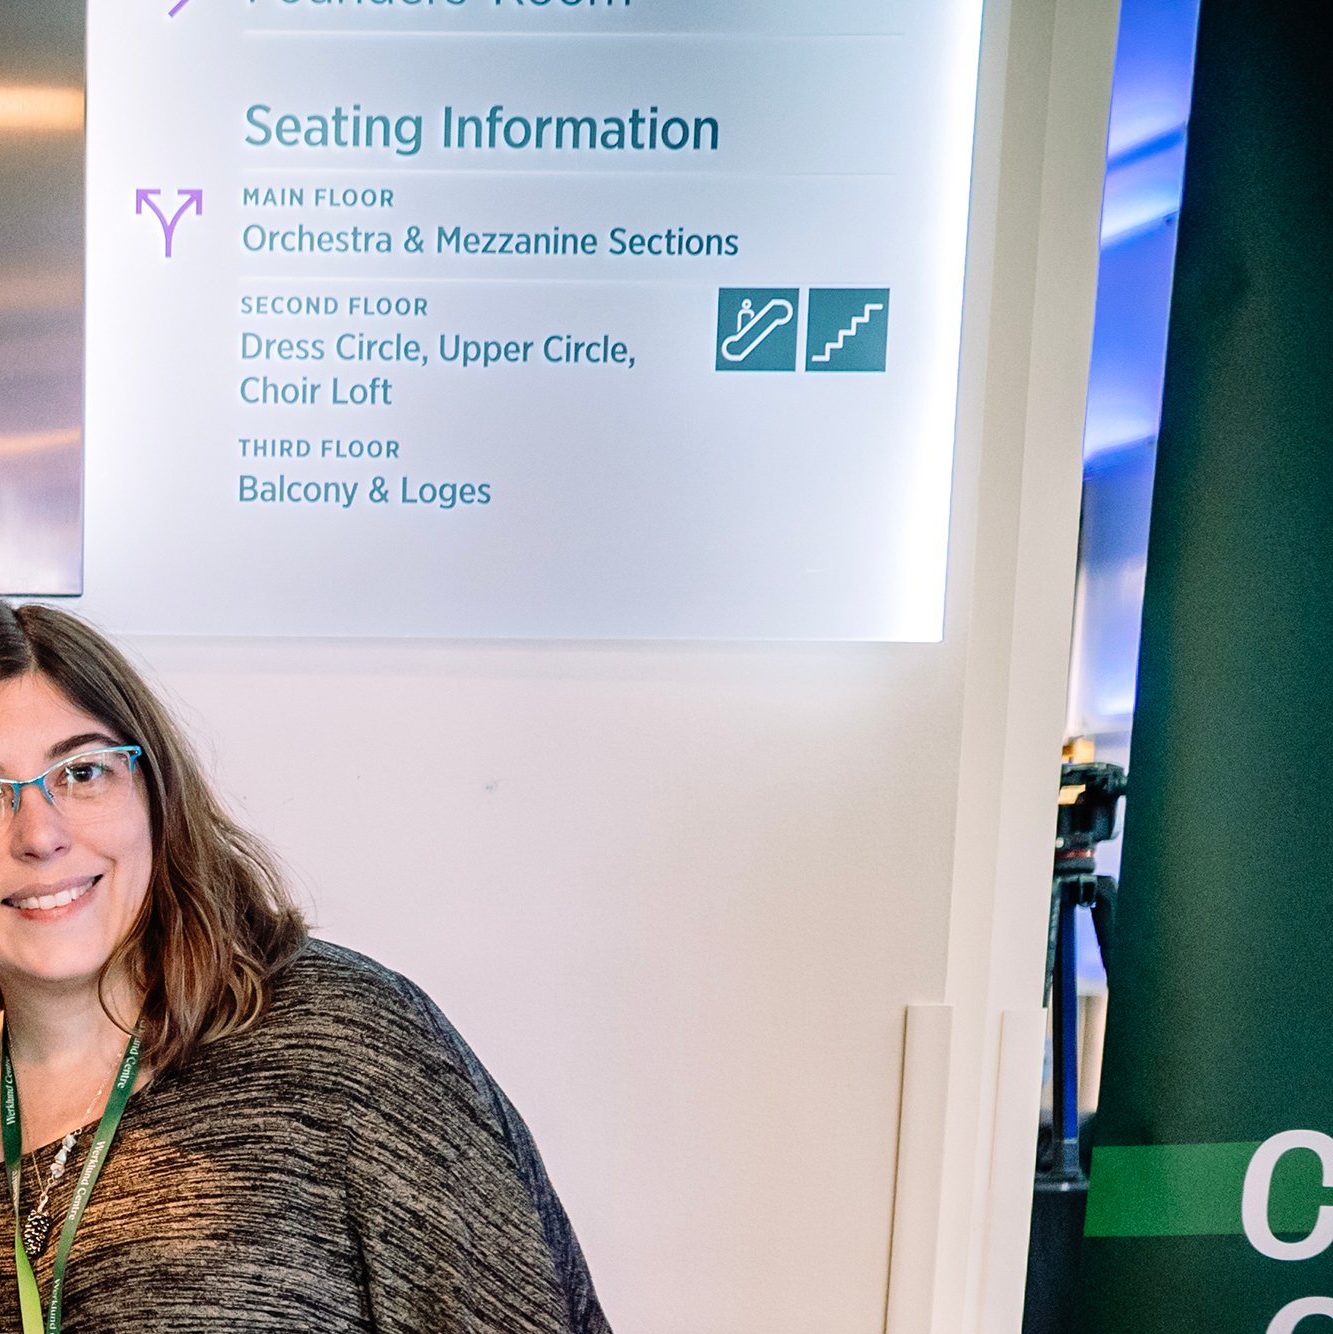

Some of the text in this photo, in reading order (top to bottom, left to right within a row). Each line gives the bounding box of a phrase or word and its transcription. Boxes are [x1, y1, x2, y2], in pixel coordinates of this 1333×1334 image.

[244, 105, 721, 155] Seating Information
[242, 188, 395, 208] MAIN FLOOR
[242, 225, 740, 258] Orchestra & Mezzanine Sections
[240, 296, 429, 317] SECOND FLOOR
[240, 333, 637, 370] Dress Circle, Upper Circle,
[240, 376, 393, 406] Choir Loft
[238, 439, 400, 460] THIRD FLOOR
[238, 475, 492, 512] Balcony & Loges
[69, 1140, 107, 1221] Werklund Centre
[49, 1279, 61, 1330] Werklund
